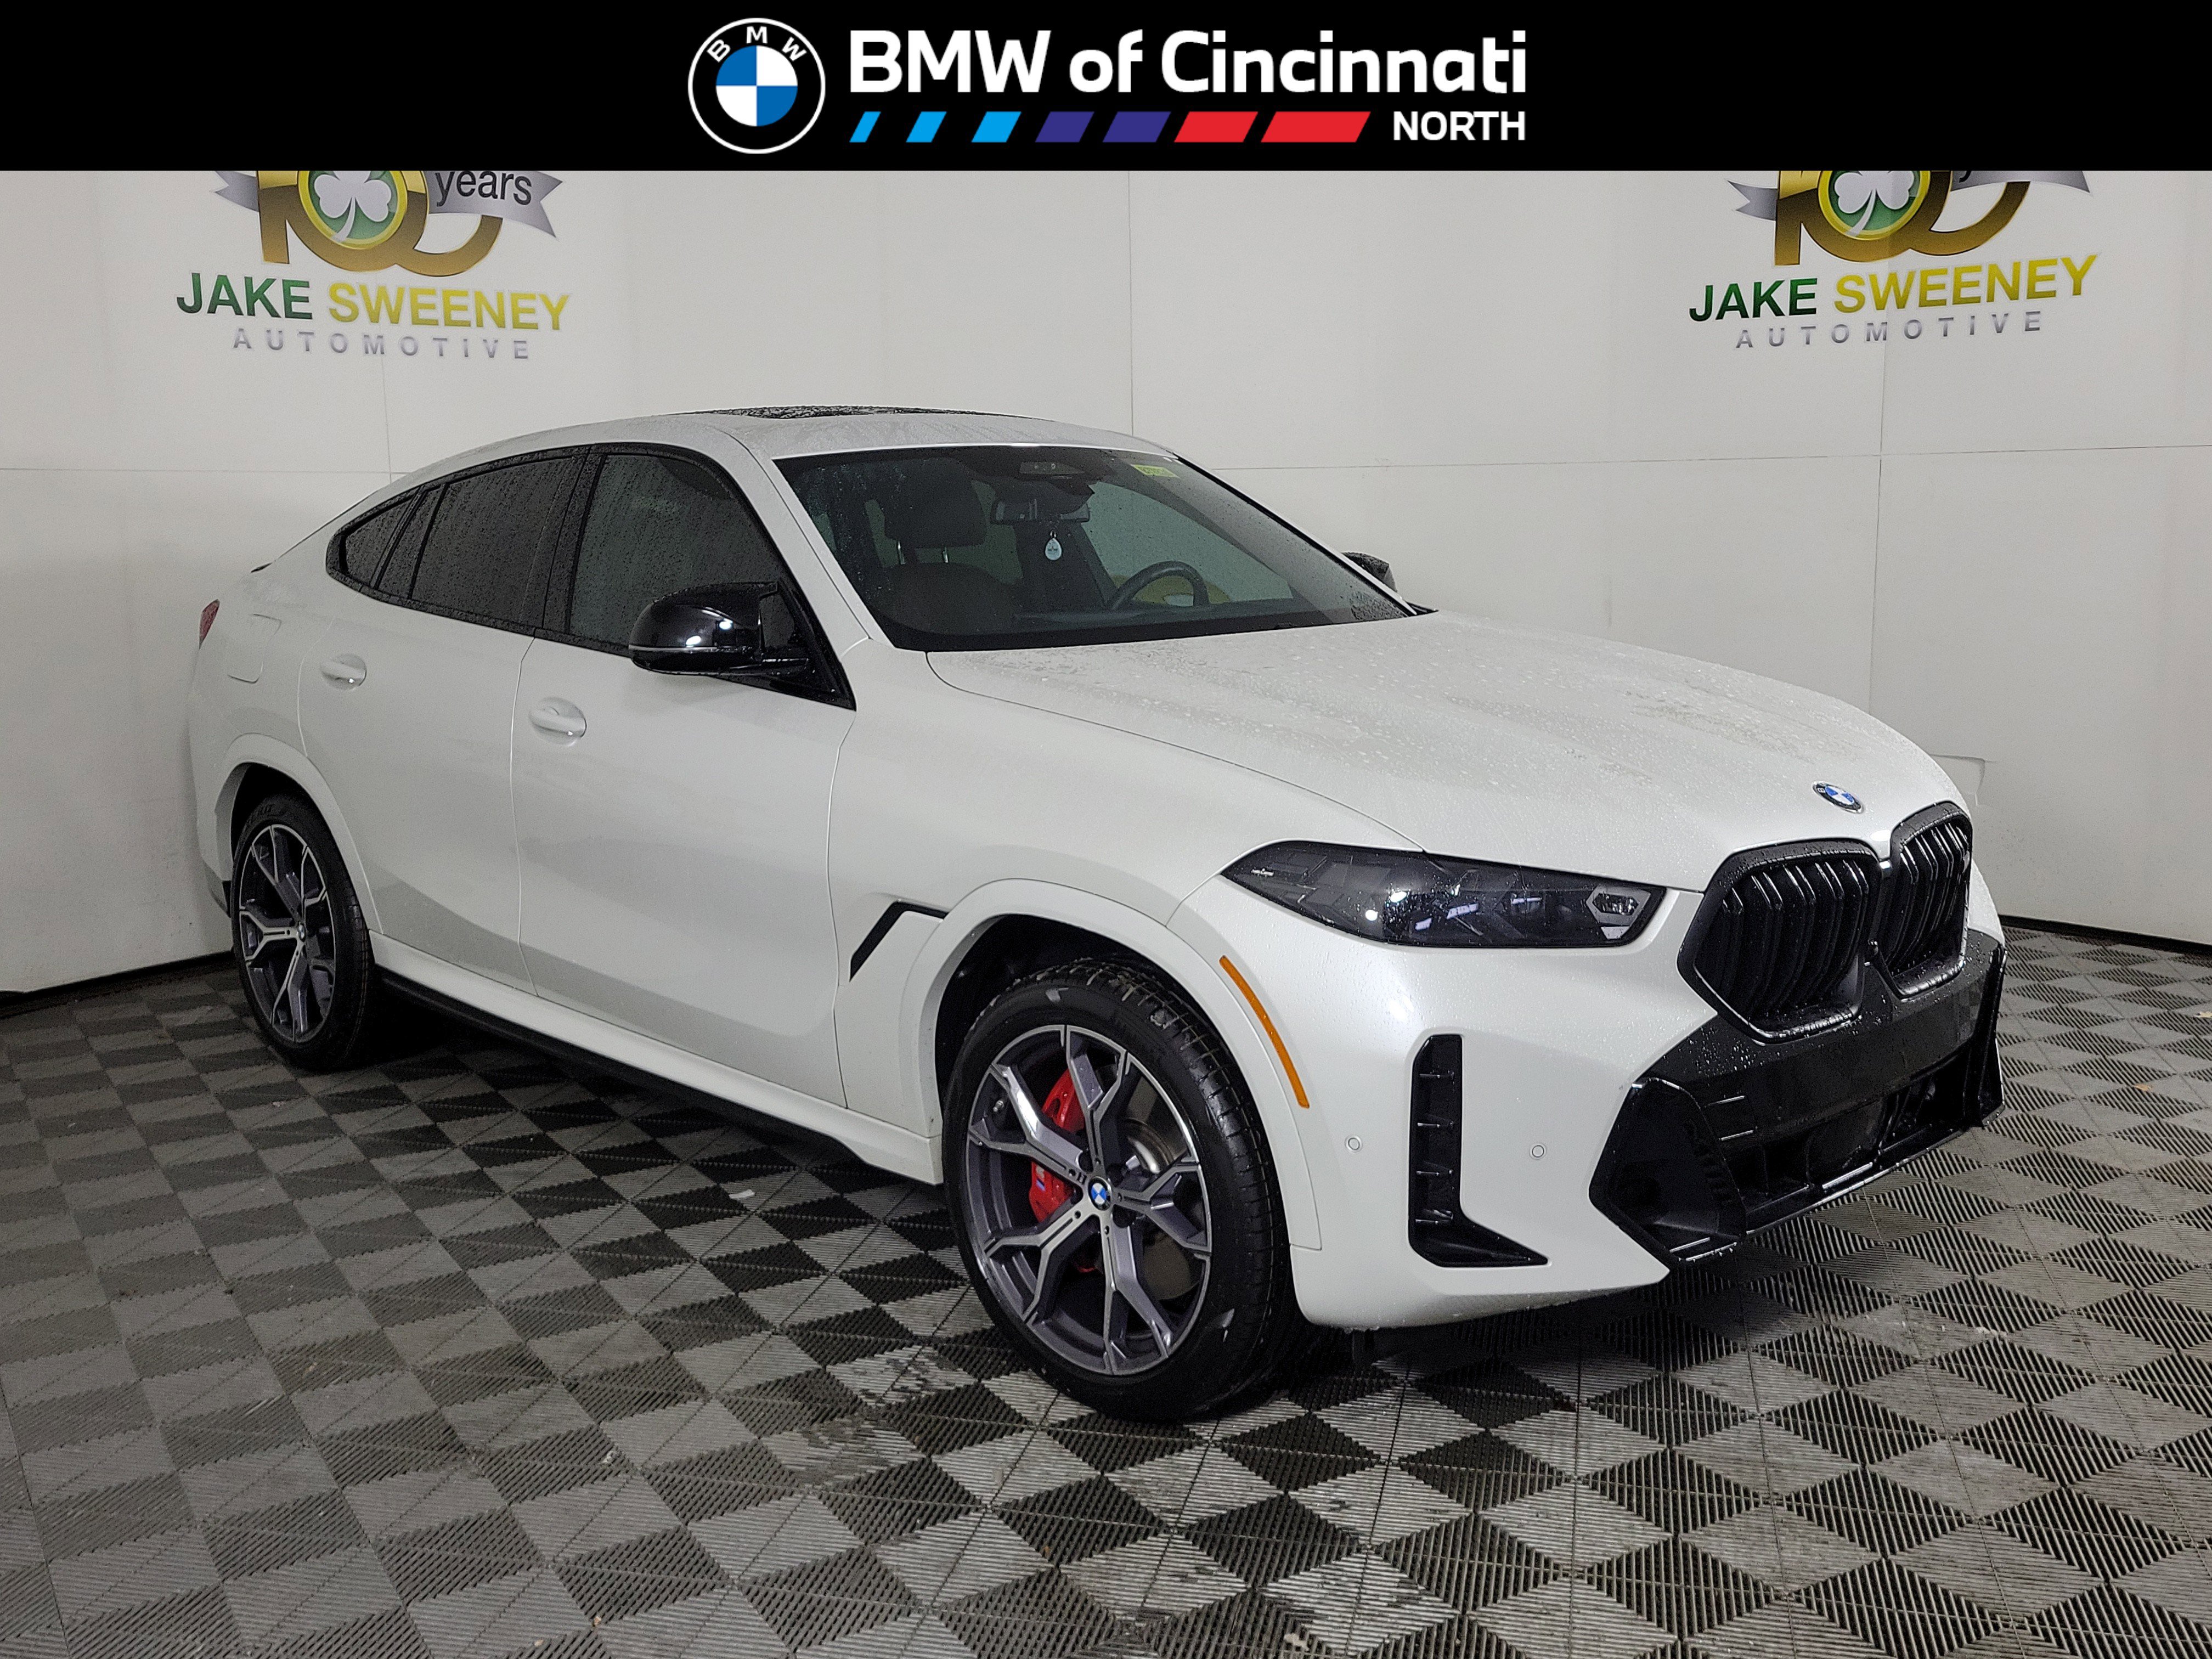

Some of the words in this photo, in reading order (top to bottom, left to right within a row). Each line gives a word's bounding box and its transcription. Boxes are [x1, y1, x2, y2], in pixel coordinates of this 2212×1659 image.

[435, 171, 532, 205] years
[176, 272, 313, 320] JAKE
[328, 282, 570, 330] SWEENEY
[1689, 277, 1818, 323] JAKE
[1833, 255, 2098, 314] SWEENEY
[233, 328, 529, 359] AUTOMOTIVE
[1735, 311, 2042, 349] AUTOMOTIVE
